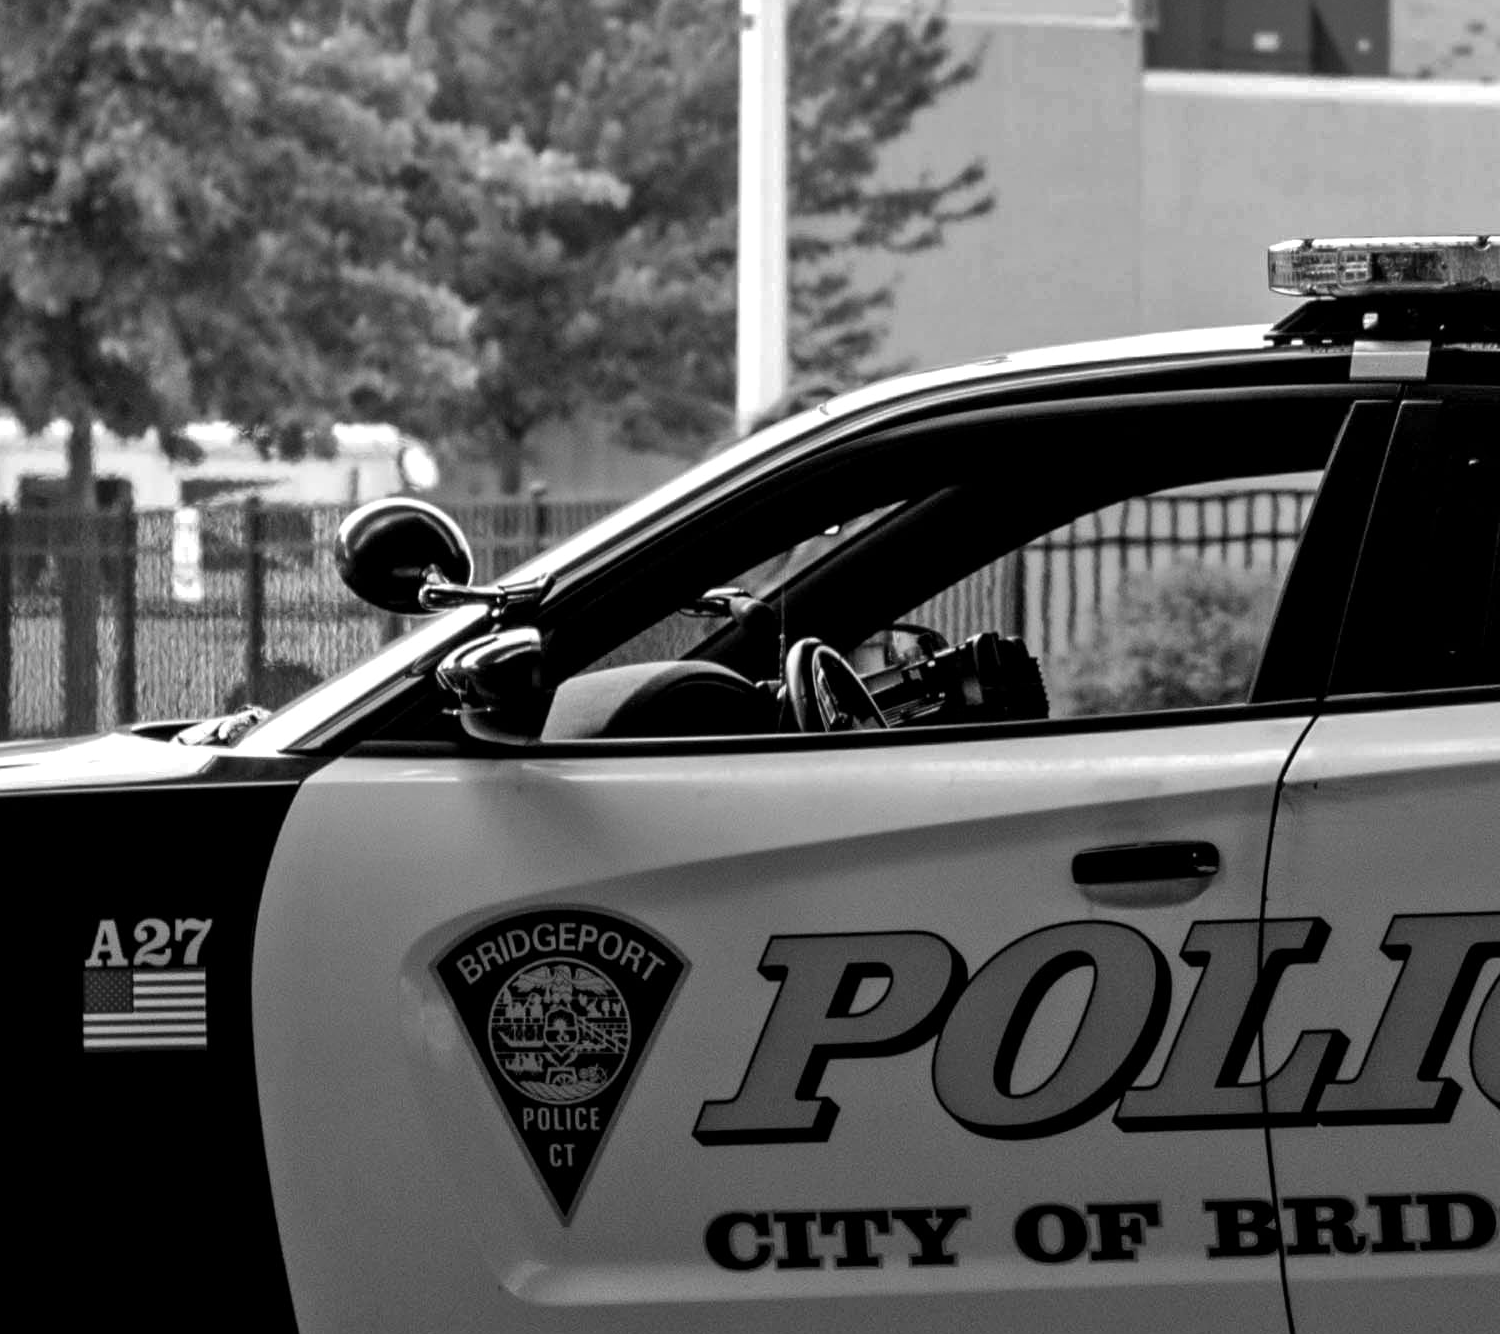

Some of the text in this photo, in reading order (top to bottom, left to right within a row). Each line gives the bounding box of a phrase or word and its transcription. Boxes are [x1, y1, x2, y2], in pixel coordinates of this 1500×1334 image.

[84, 917, 213, 967] A27
[456, 922, 666, 985] BRIDGEPORT
[523, 1107, 601, 1131] POLICE
[549, 1143, 576, 1168] CT
[702, 1205, 969, 1273] CITY
[1012, 1200, 1162, 1264] OF
